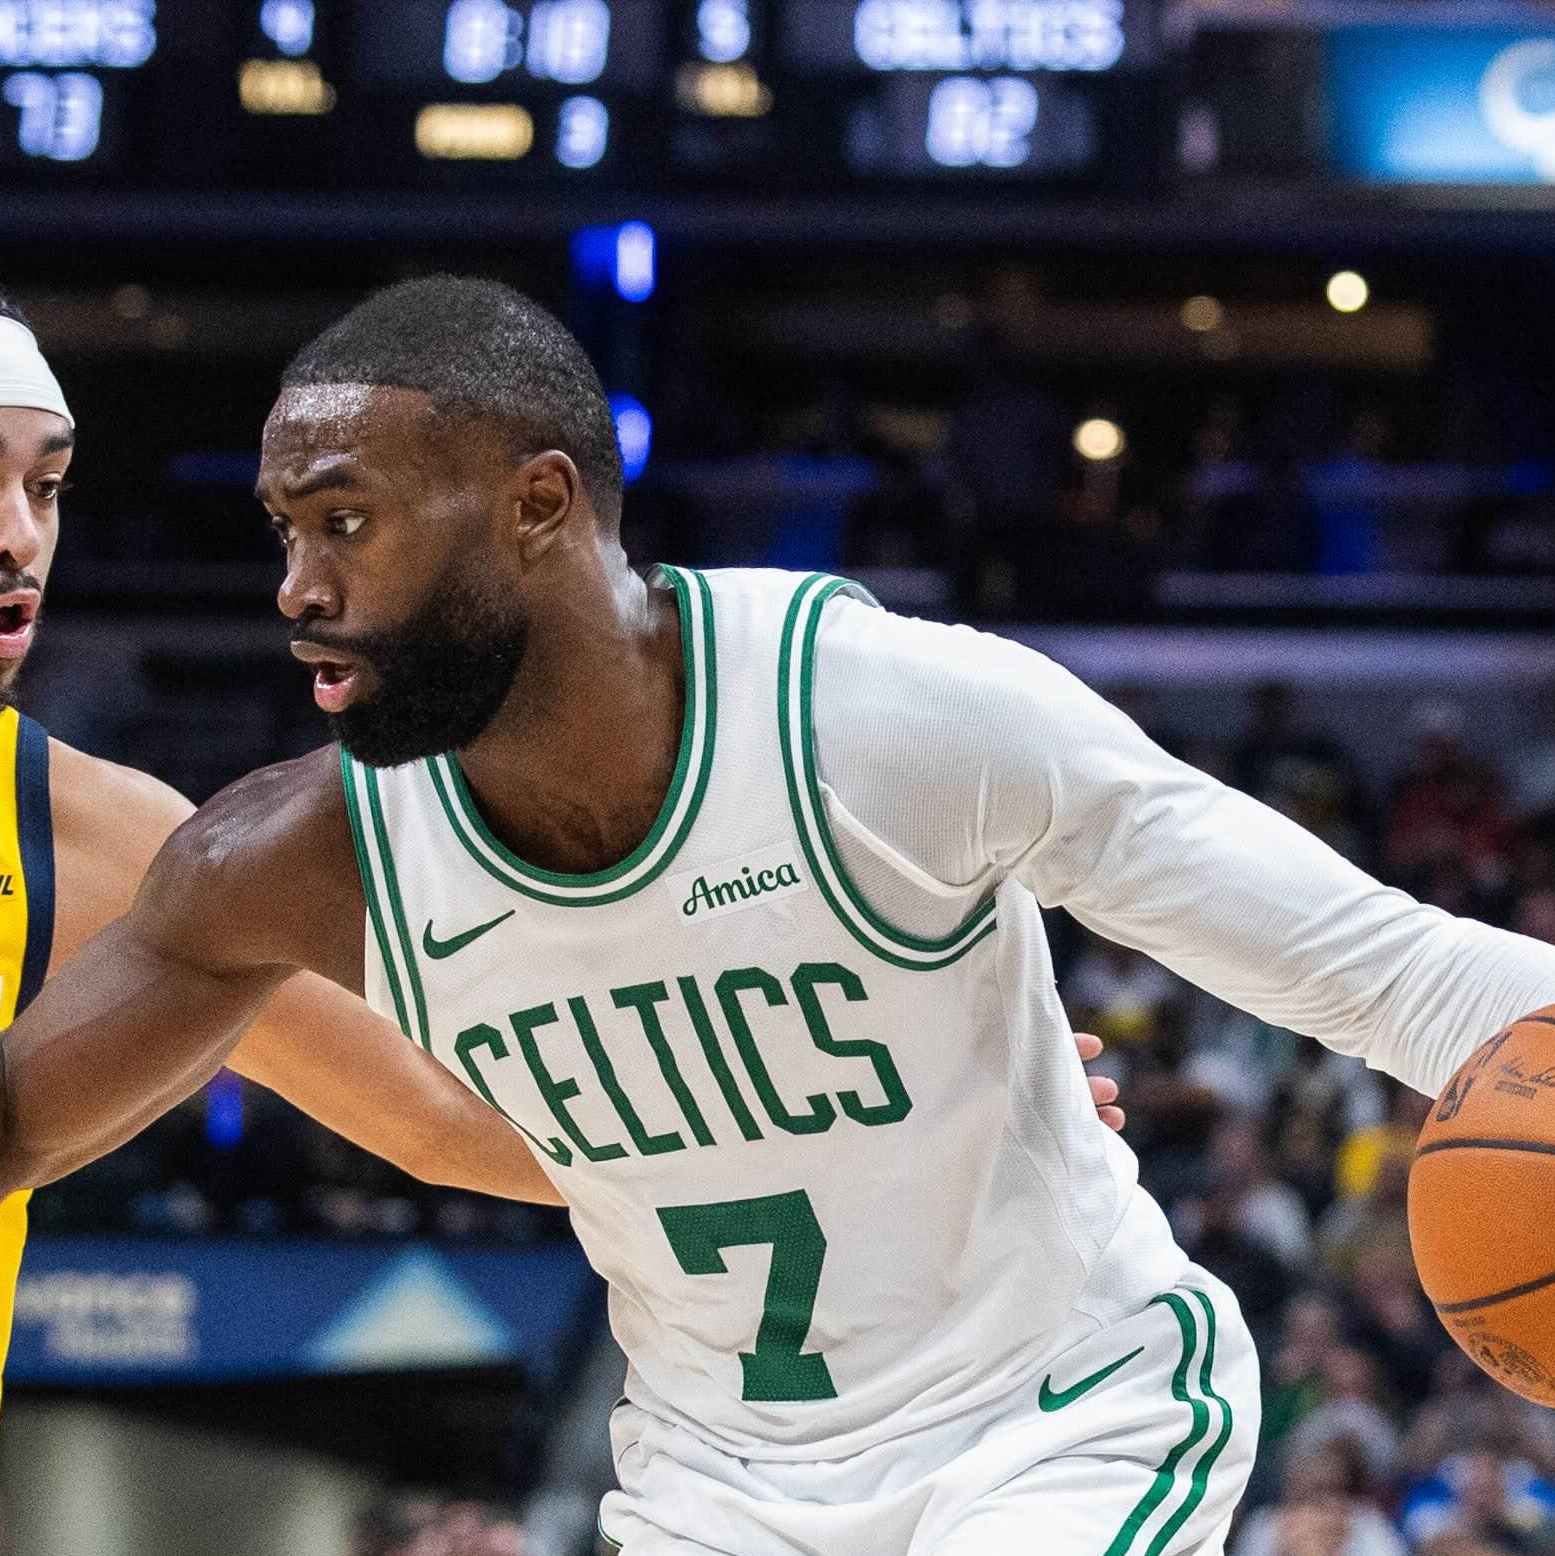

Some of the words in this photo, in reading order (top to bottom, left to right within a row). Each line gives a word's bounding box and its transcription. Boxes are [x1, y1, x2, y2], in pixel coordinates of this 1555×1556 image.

[854, 0, 1125, 70] CELTICS
[682, 862, 801, 916] Amica
[454, 961, 914, 1167] CELTICS
[655, 1188, 839, 1402] 7
